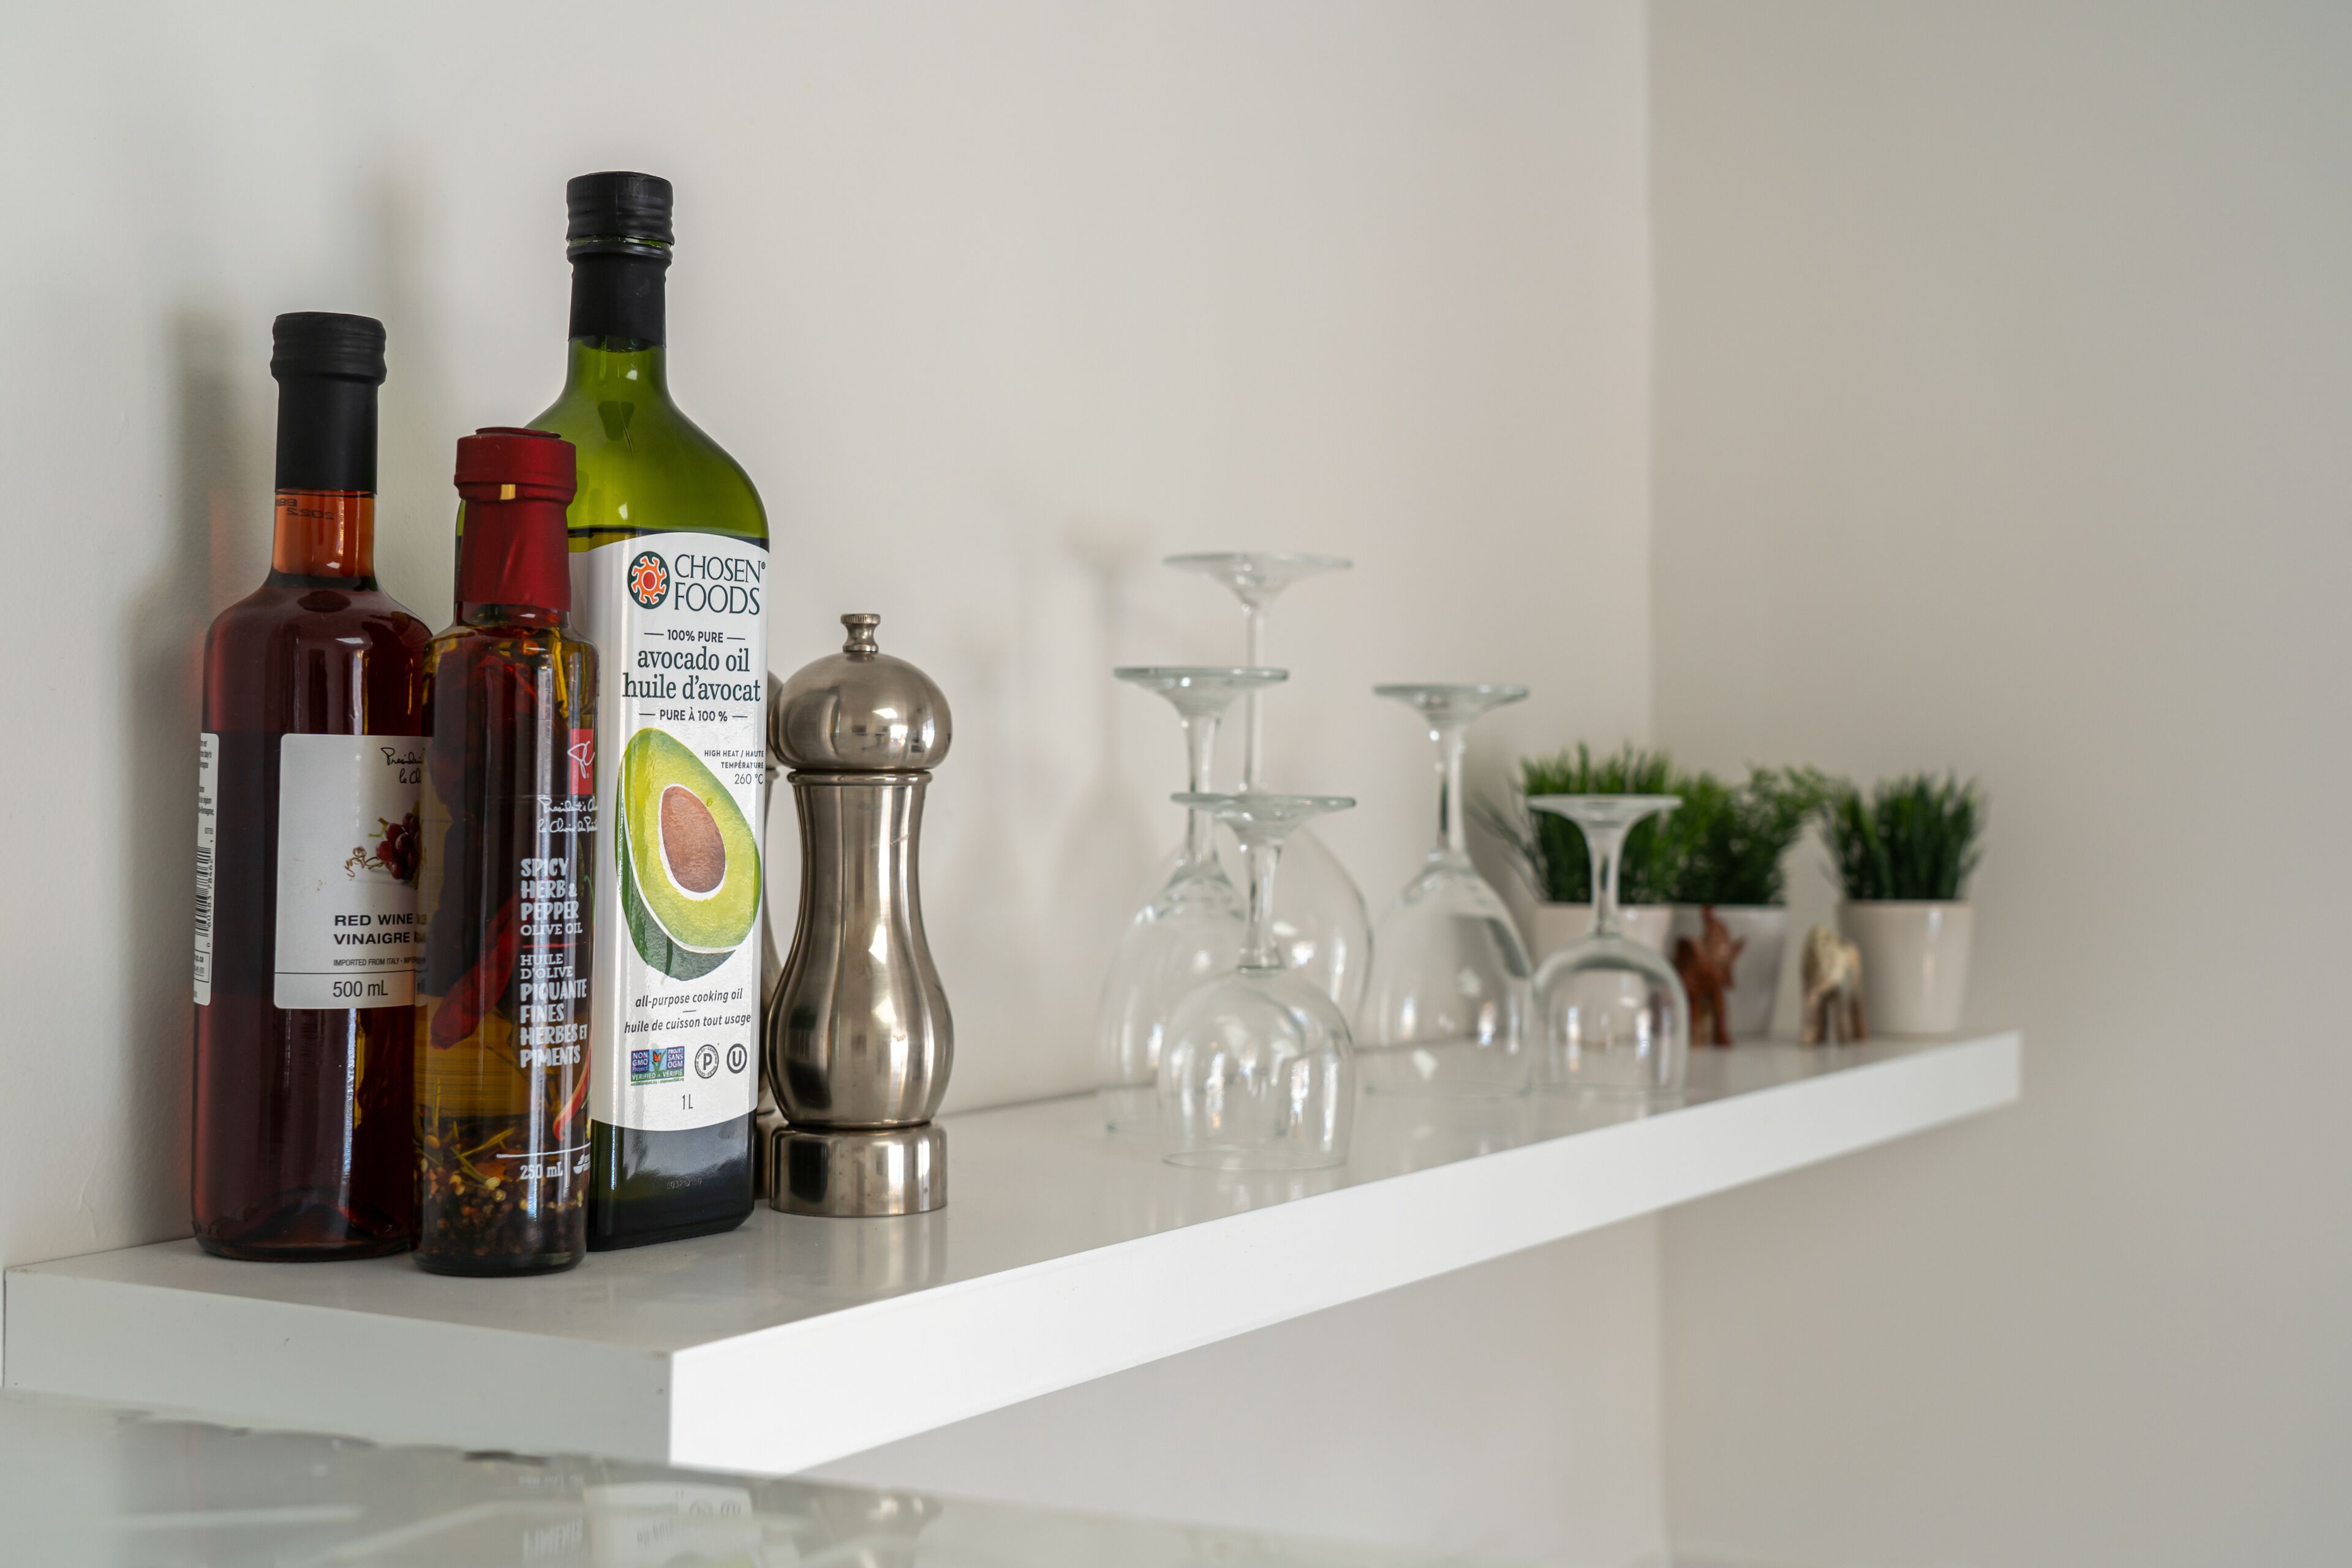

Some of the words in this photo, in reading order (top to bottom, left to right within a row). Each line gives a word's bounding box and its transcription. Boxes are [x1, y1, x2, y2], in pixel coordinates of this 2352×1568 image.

[674, 582, 760, 615] FOODS
[668, 630, 695, 641] 100%
[698, 631, 723, 643] PURE
[638, 646, 720, 671] avocado
[726, 648, 750, 672] oil
[622, 673, 676, 699] huile
[682, 675, 761, 701] d'avocat
[660, 709, 685, 720] PURE
[688, 707, 695, 721] À
[698, 710, 715, 722] 100
[718, 711, 728, 722] %
[721, 760, 763, 769] TEMPÉRATURE
[734, 774, 752, 784] 260
[521, 858, 568, 876] SPICY
[521, 880, 565, 899] HERB
[568, 883, 577, 897] &
[334, 915, 371, 925] RED
[377, 913, 413, 925] WINE
[521, 901, 579, 921] PEPPER
[520, 924, 562, 935] OLIVE
[565, 922, 582, 933] OIL
[334, 932, 410, 944] VINAIGRE
[521, 954, 563, 966] HUILE
[521, 966, 573, 979] D'OLIVE
[333, 981, 363, 997] 500
[368, 980, 388, 996] mL
[521, 979, 587, 1002] PIQUANTE
[636, 995, 690, 1009] all-purpose
[693, 990, 728, 1003] cooking
[731, 988, 743, 999] oil
[521, 1003, 564, 1023] FINES
[624, 1021, 649, 1033] huile
[652, 1019, 663, 1031] de
[666, 1018, 700, 1030] cuisson
[704, 1015, 722, 1027] tout
[725, 1014, 751, 1026] usage
[520, 1023, 578, 1046] HERBES
[579, 1024, 587, 1040] ET
[520, 1044, 580, 1068] PIMENTS
[703, 1053, 712, 1071] P
[733, 1050, 742, 1068] U
[682, 1095, 685, 1109] 1
[688, 1094, 693, 1109] L
[519, 1164, 543, 1180] 250
[546, 1161, 564, 1177] mL
